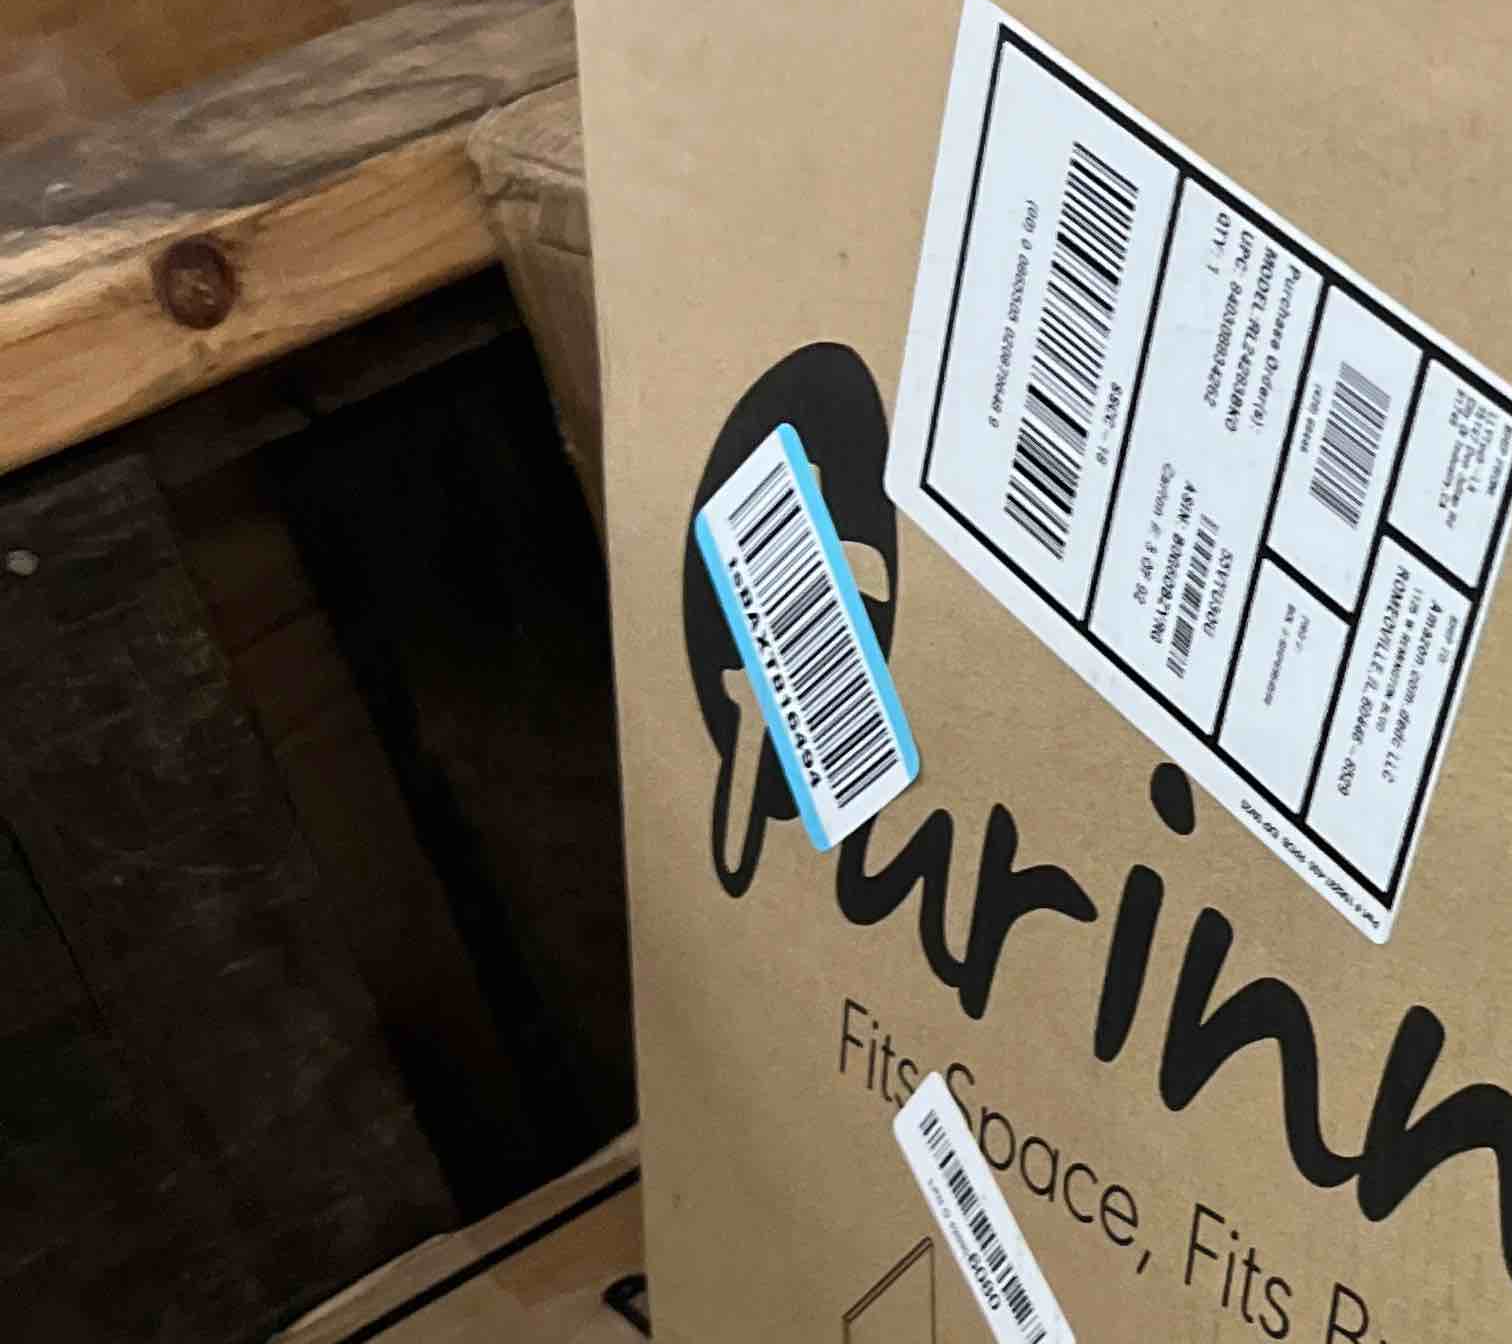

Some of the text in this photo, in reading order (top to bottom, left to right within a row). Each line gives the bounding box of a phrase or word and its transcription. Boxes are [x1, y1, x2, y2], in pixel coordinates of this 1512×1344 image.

[1268, 261, 1302, 356] Purchase
[840, 999, 920, 1110] Fits
[1186, 1204, 1294, 1341] Fits
